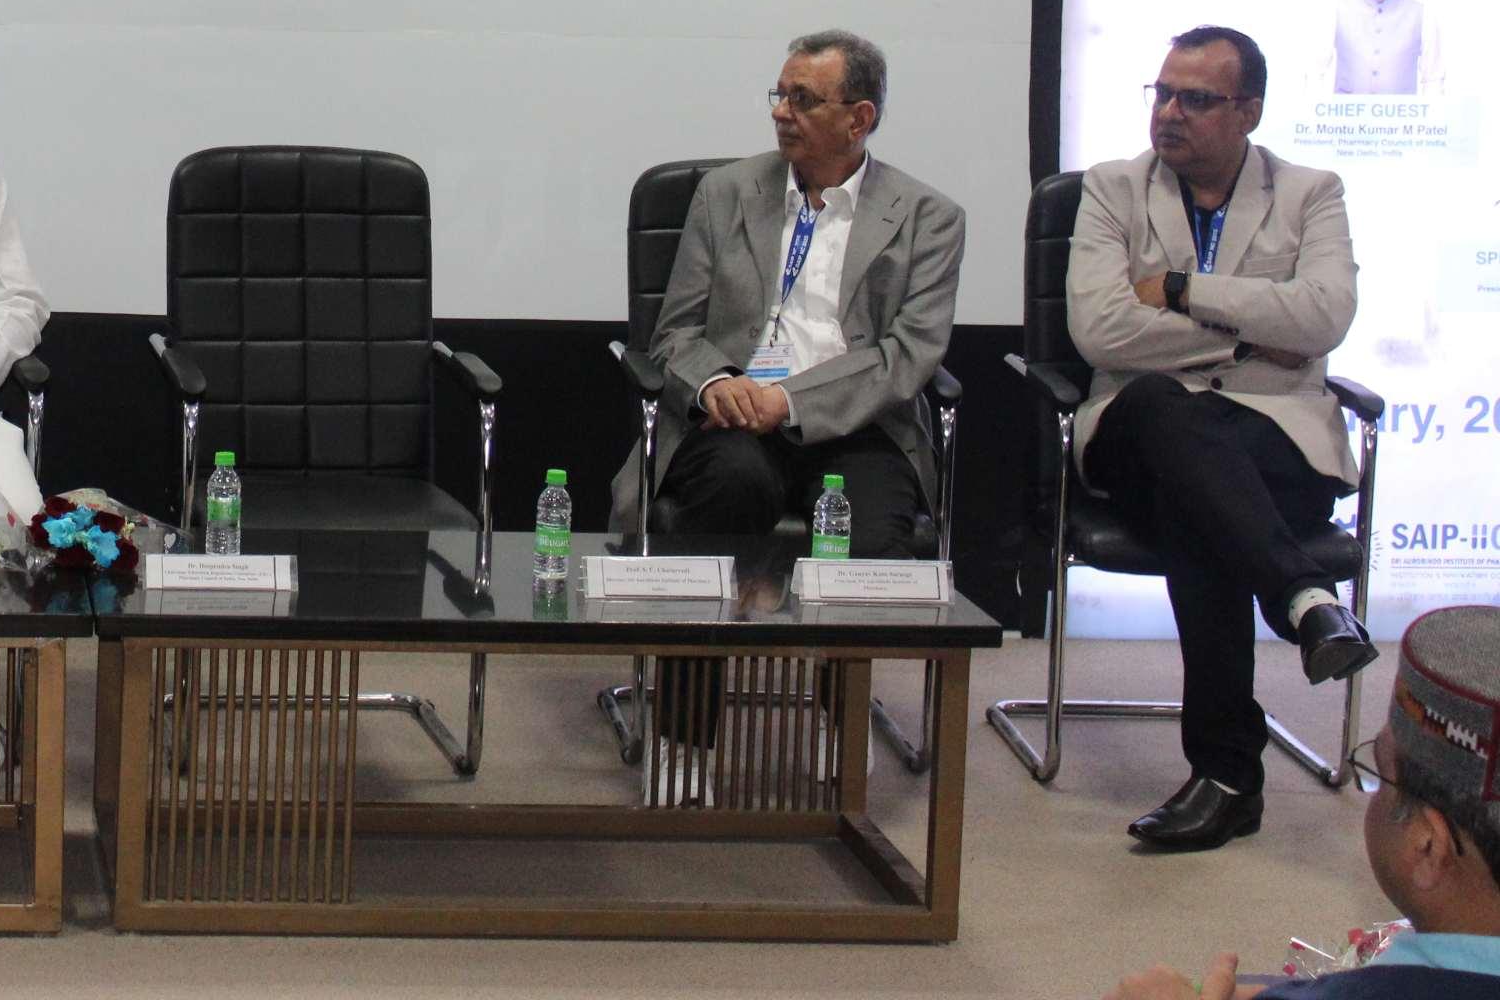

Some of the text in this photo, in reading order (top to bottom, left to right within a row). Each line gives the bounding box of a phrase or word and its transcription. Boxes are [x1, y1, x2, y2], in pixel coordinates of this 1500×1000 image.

[1315, 103, 1429, 117] CHIEF GUEST
[1316, 124, 1355, 135] Montu
[1358, 124, 1398, 135] Kumar
